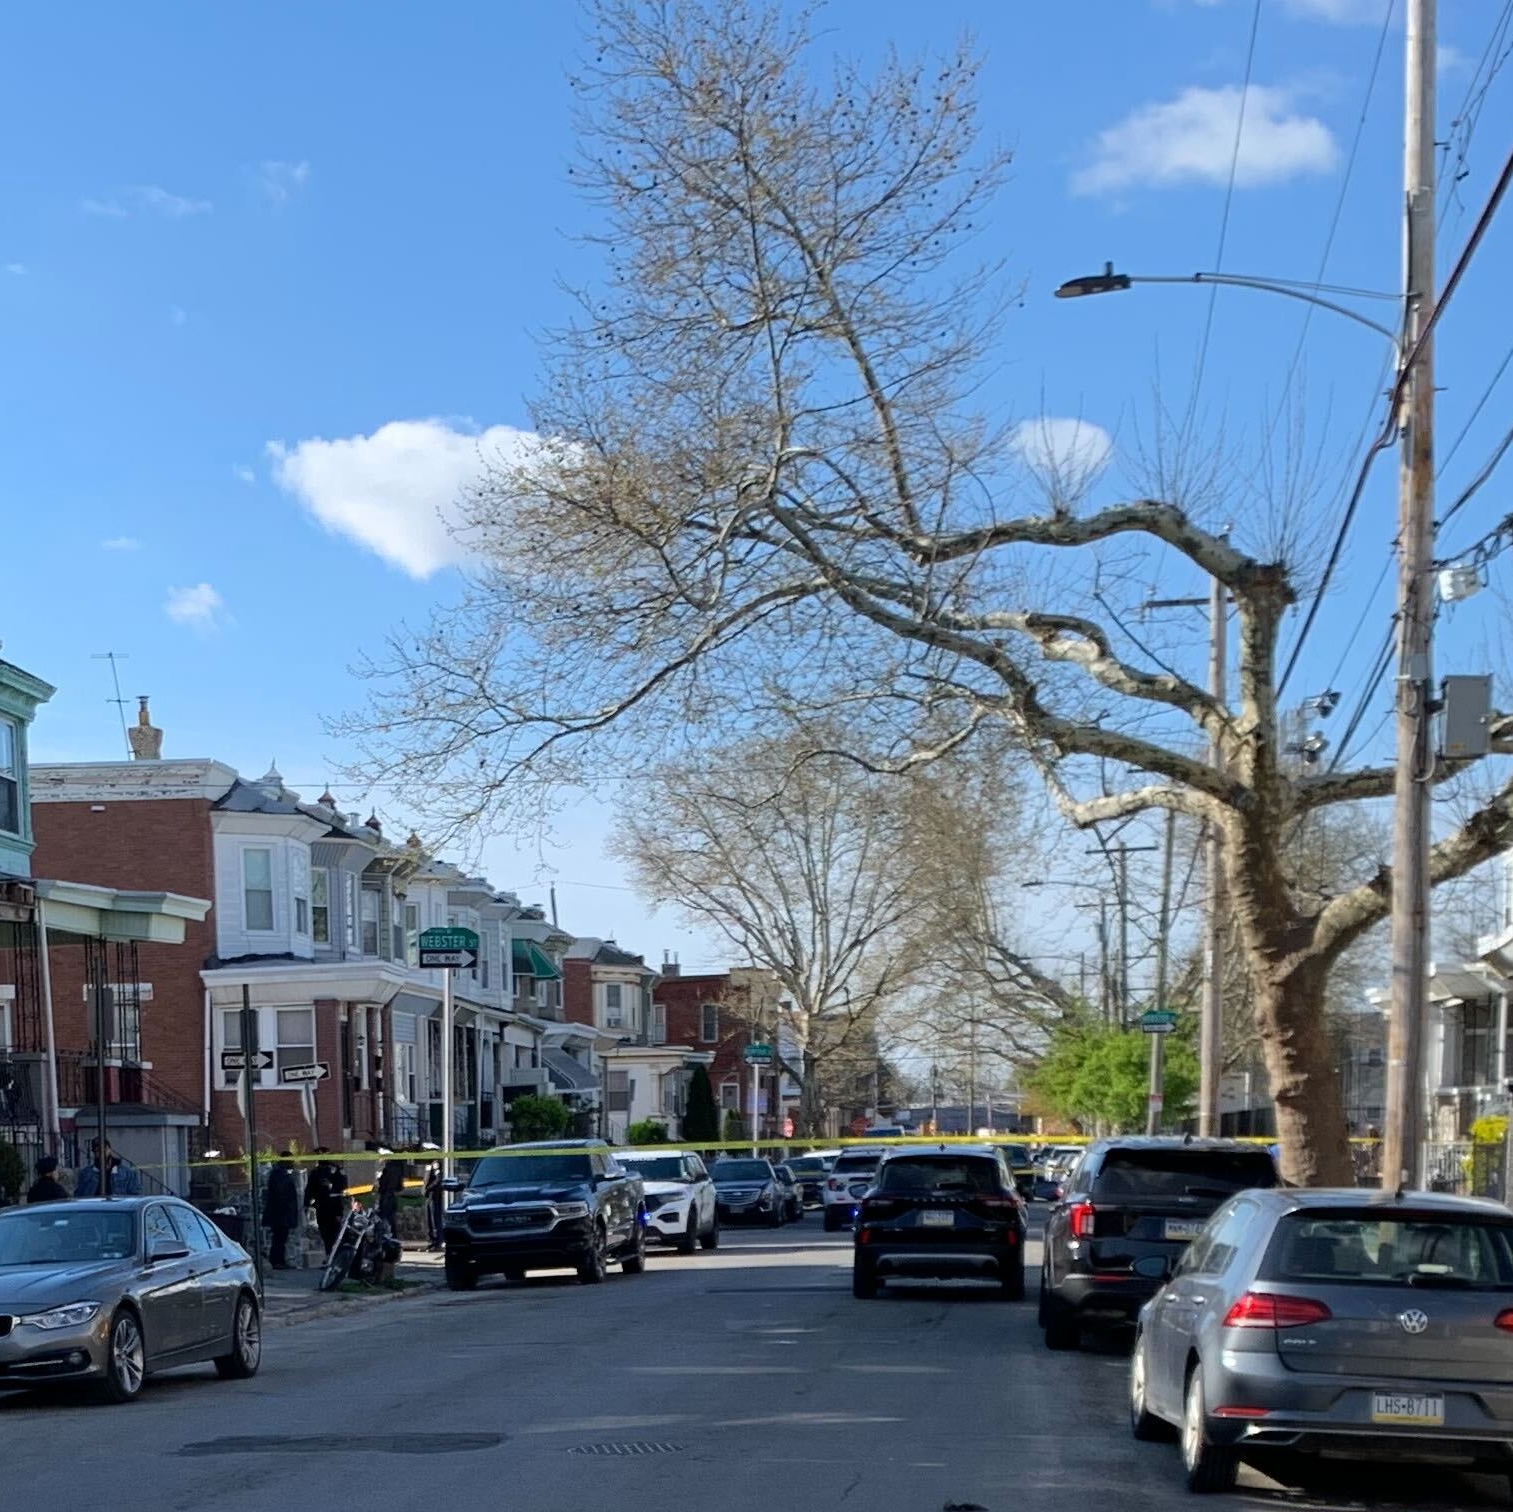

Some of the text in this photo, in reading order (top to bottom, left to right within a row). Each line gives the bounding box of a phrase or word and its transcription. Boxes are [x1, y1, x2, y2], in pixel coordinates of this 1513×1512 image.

[420, 935, 466, 948] WEBSTER
[425, 954, 461, 963] ONE WAY
